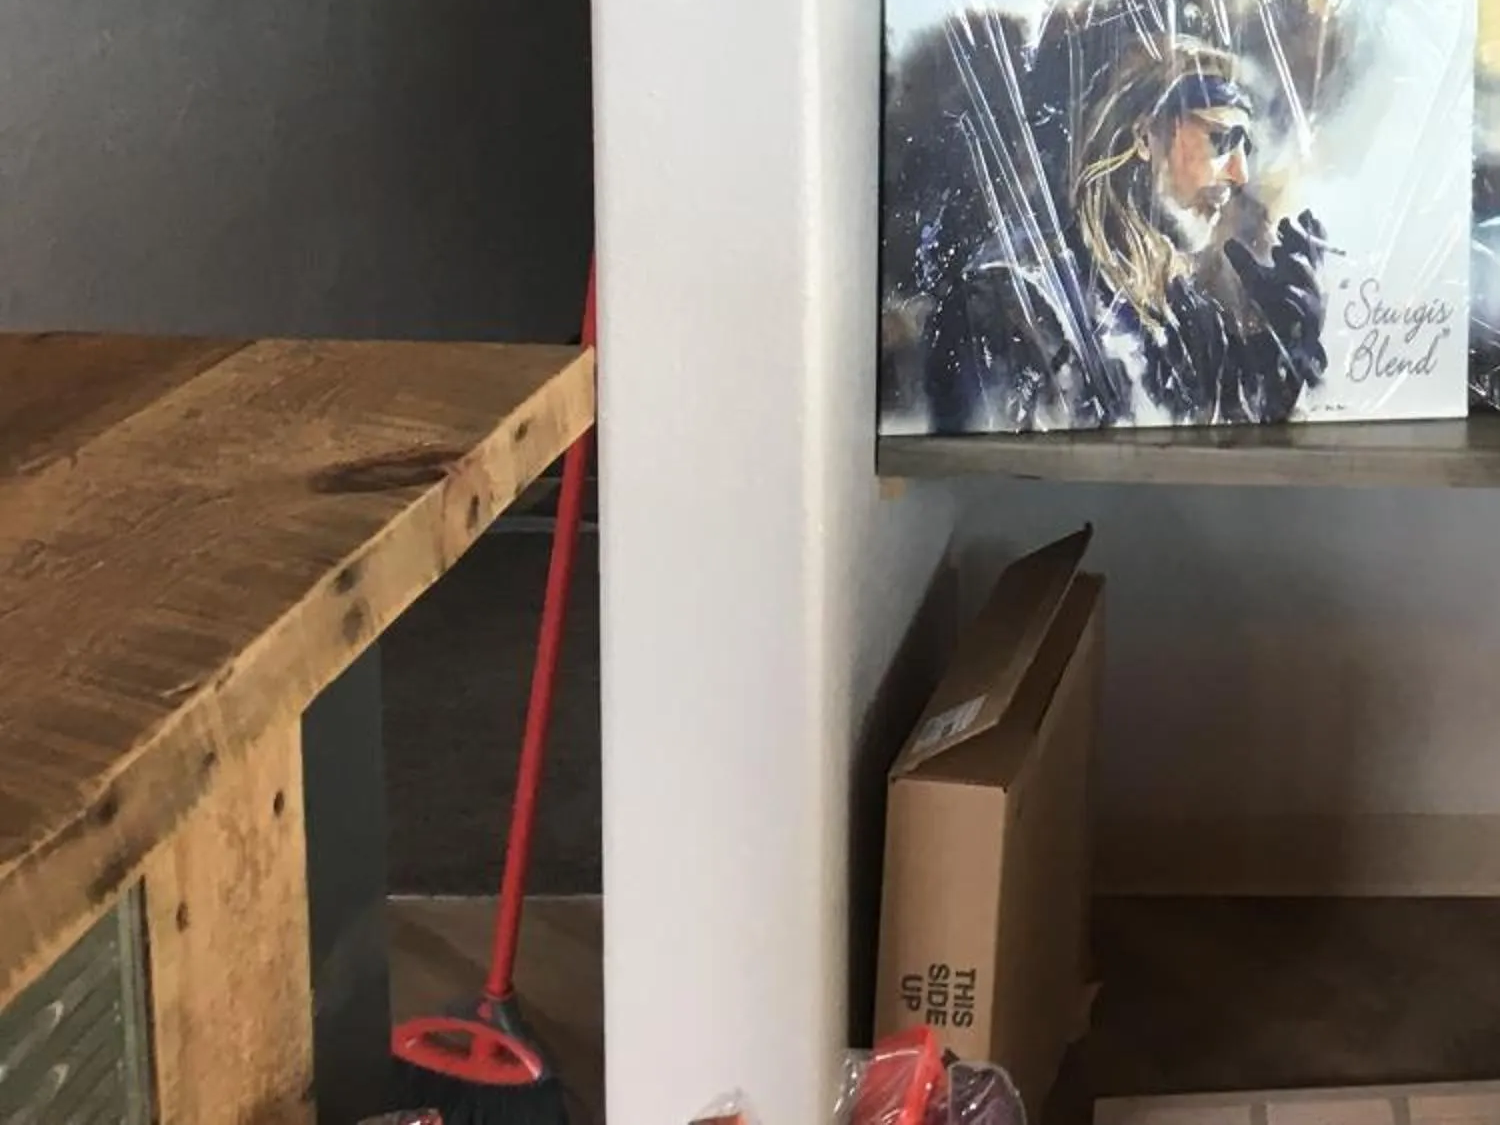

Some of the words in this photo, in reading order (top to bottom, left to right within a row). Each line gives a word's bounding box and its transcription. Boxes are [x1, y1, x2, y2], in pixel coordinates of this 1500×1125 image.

[902, 973, 923, 1011] UP
[926, 963, 950, 1026] SIDE
[952, 968, 976, 1028] THIS
